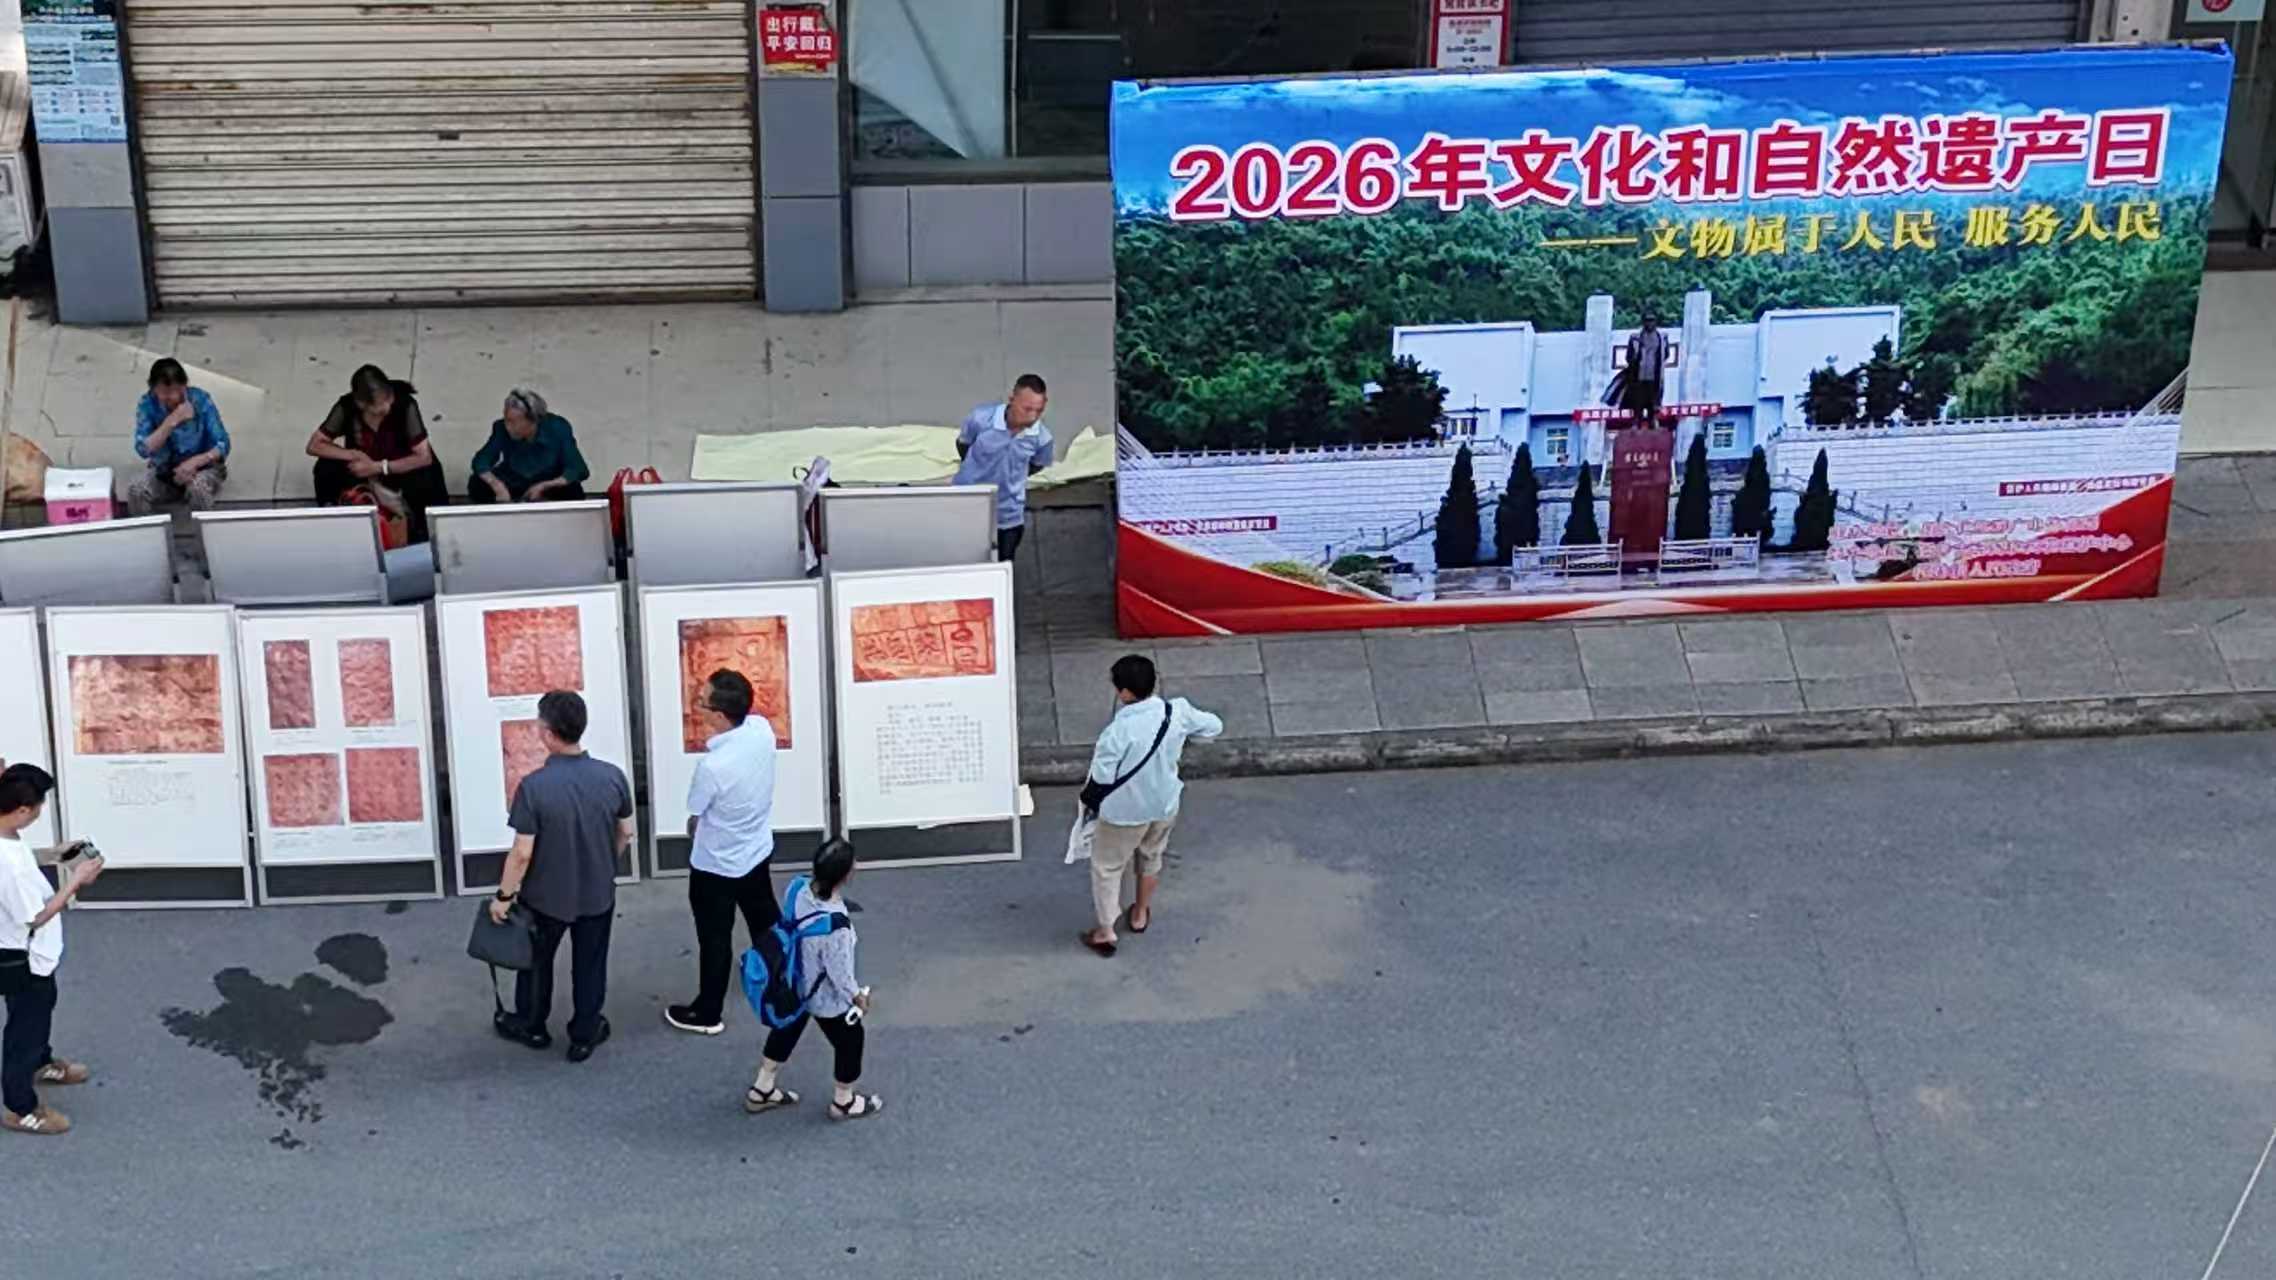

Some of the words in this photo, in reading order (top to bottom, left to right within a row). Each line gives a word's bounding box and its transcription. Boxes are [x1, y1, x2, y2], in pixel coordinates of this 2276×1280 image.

[766, 35, 832, 52] 平安回归
[1170, 108, 2171, 221] 2026年文化和自然遗产日
[1965, 201, 2163, 247] 服务人民
